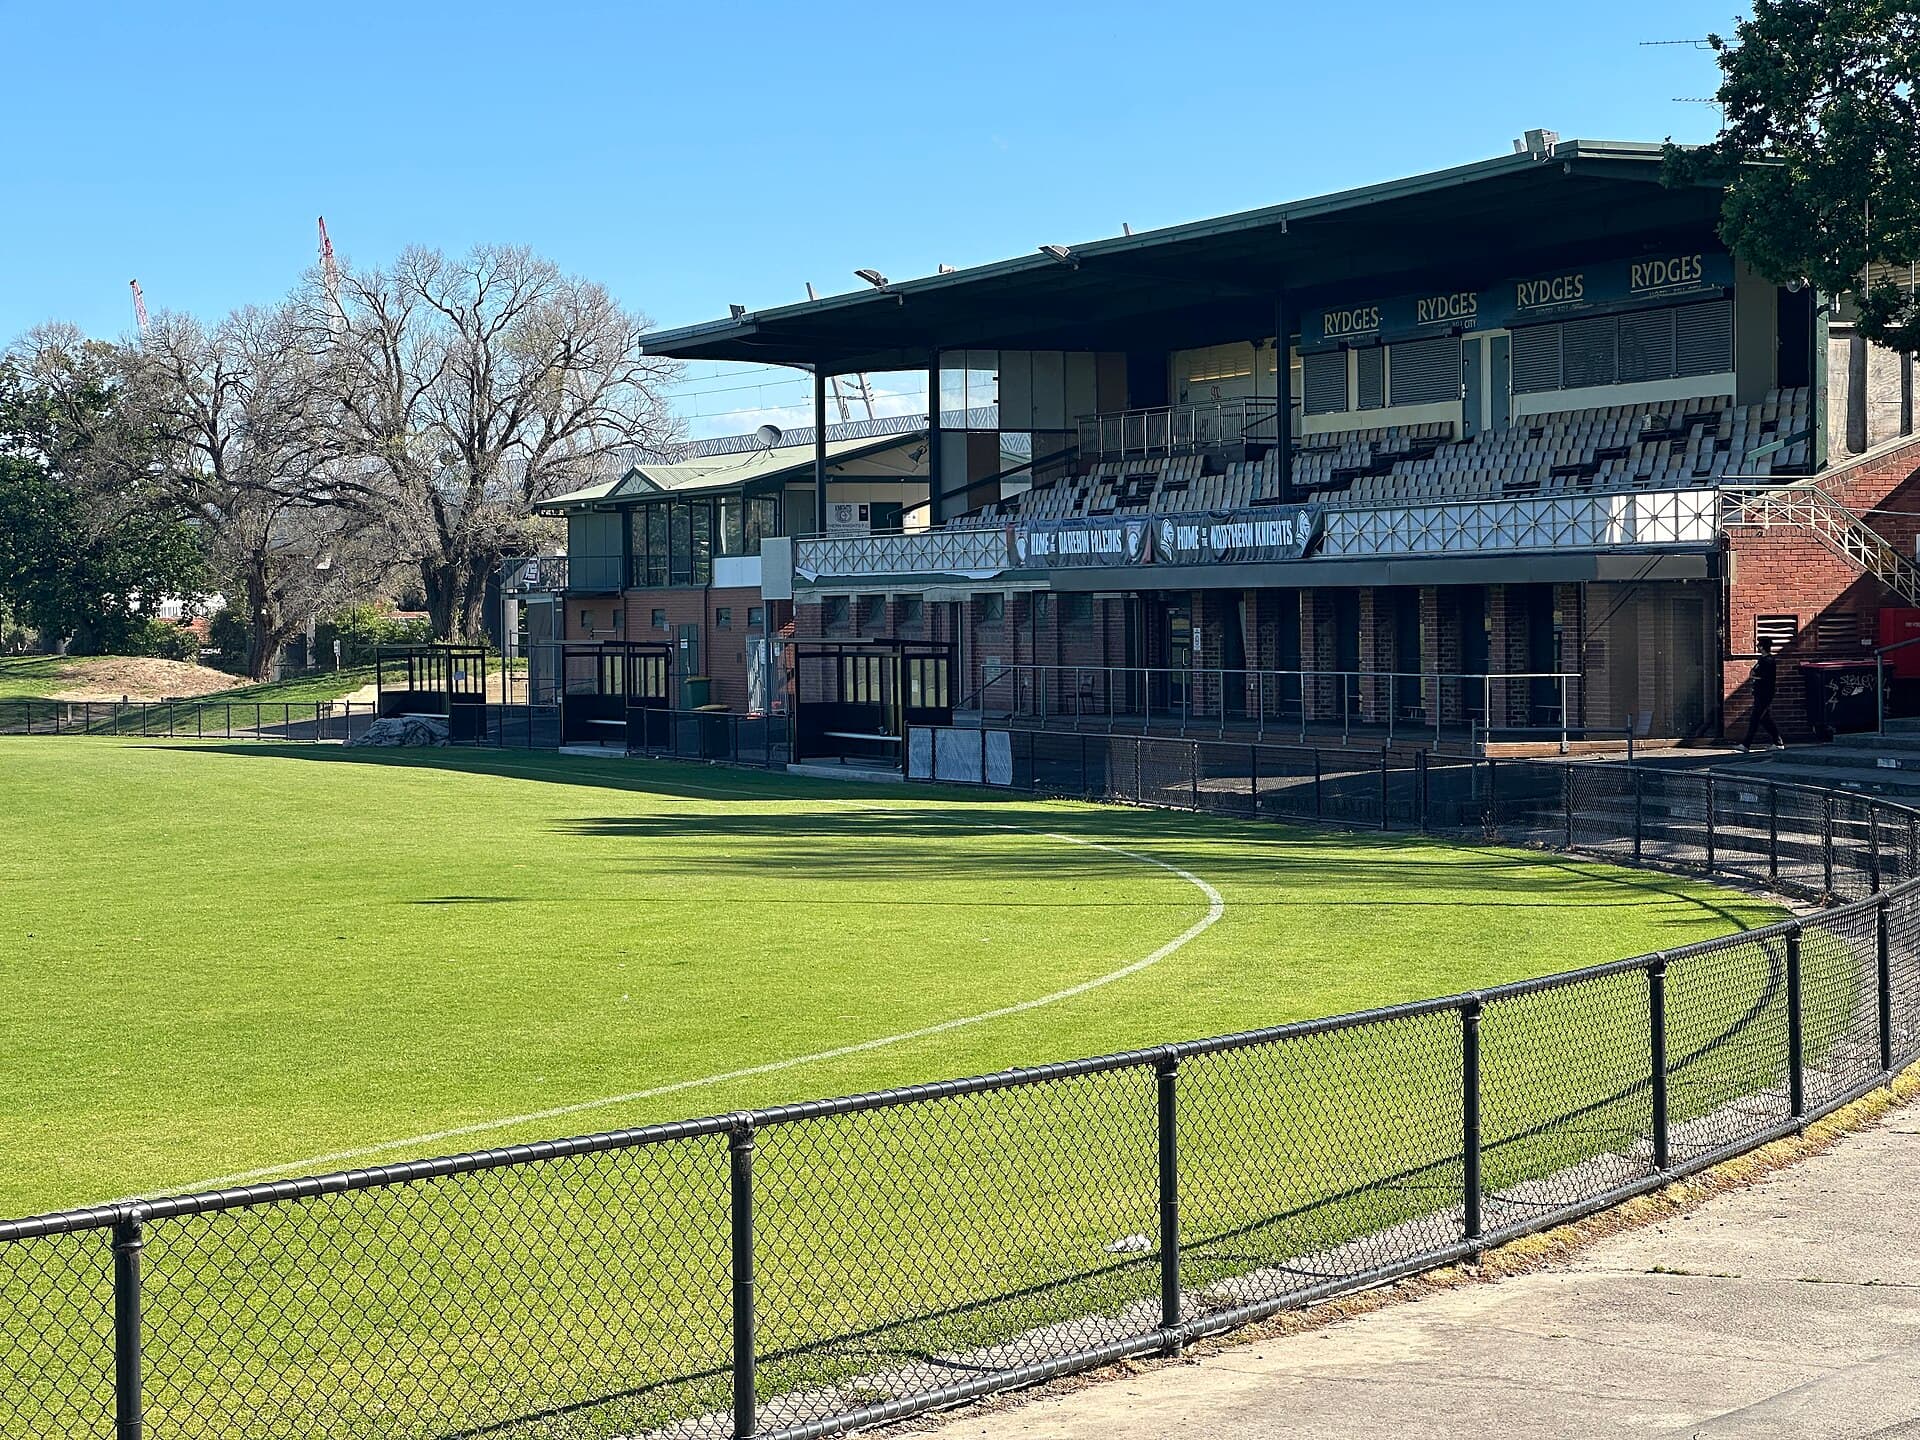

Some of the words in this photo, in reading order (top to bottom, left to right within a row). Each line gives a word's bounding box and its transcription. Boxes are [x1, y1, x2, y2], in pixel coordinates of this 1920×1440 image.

[1631, 254, 1703, 289] RYDGES
[1516, 274, 1584, 307] RYDGES
[1324, 306, 1379, 334] RYDGES
[1417, 292, 1478, 322] RYDGES
[1464, 319, 1478, 329] CITY
[1030, 532, 1049, 555] HOME
[1058, 530, 1090, 555] DAREBIN
[1091, 529, 1122, 553] FALCONS
[1177, 525, 1200, 550] HOME
[1211, 522, 1254, 550] NORTHERN
[1255, 519, 1293, 547] KNIGHTS
